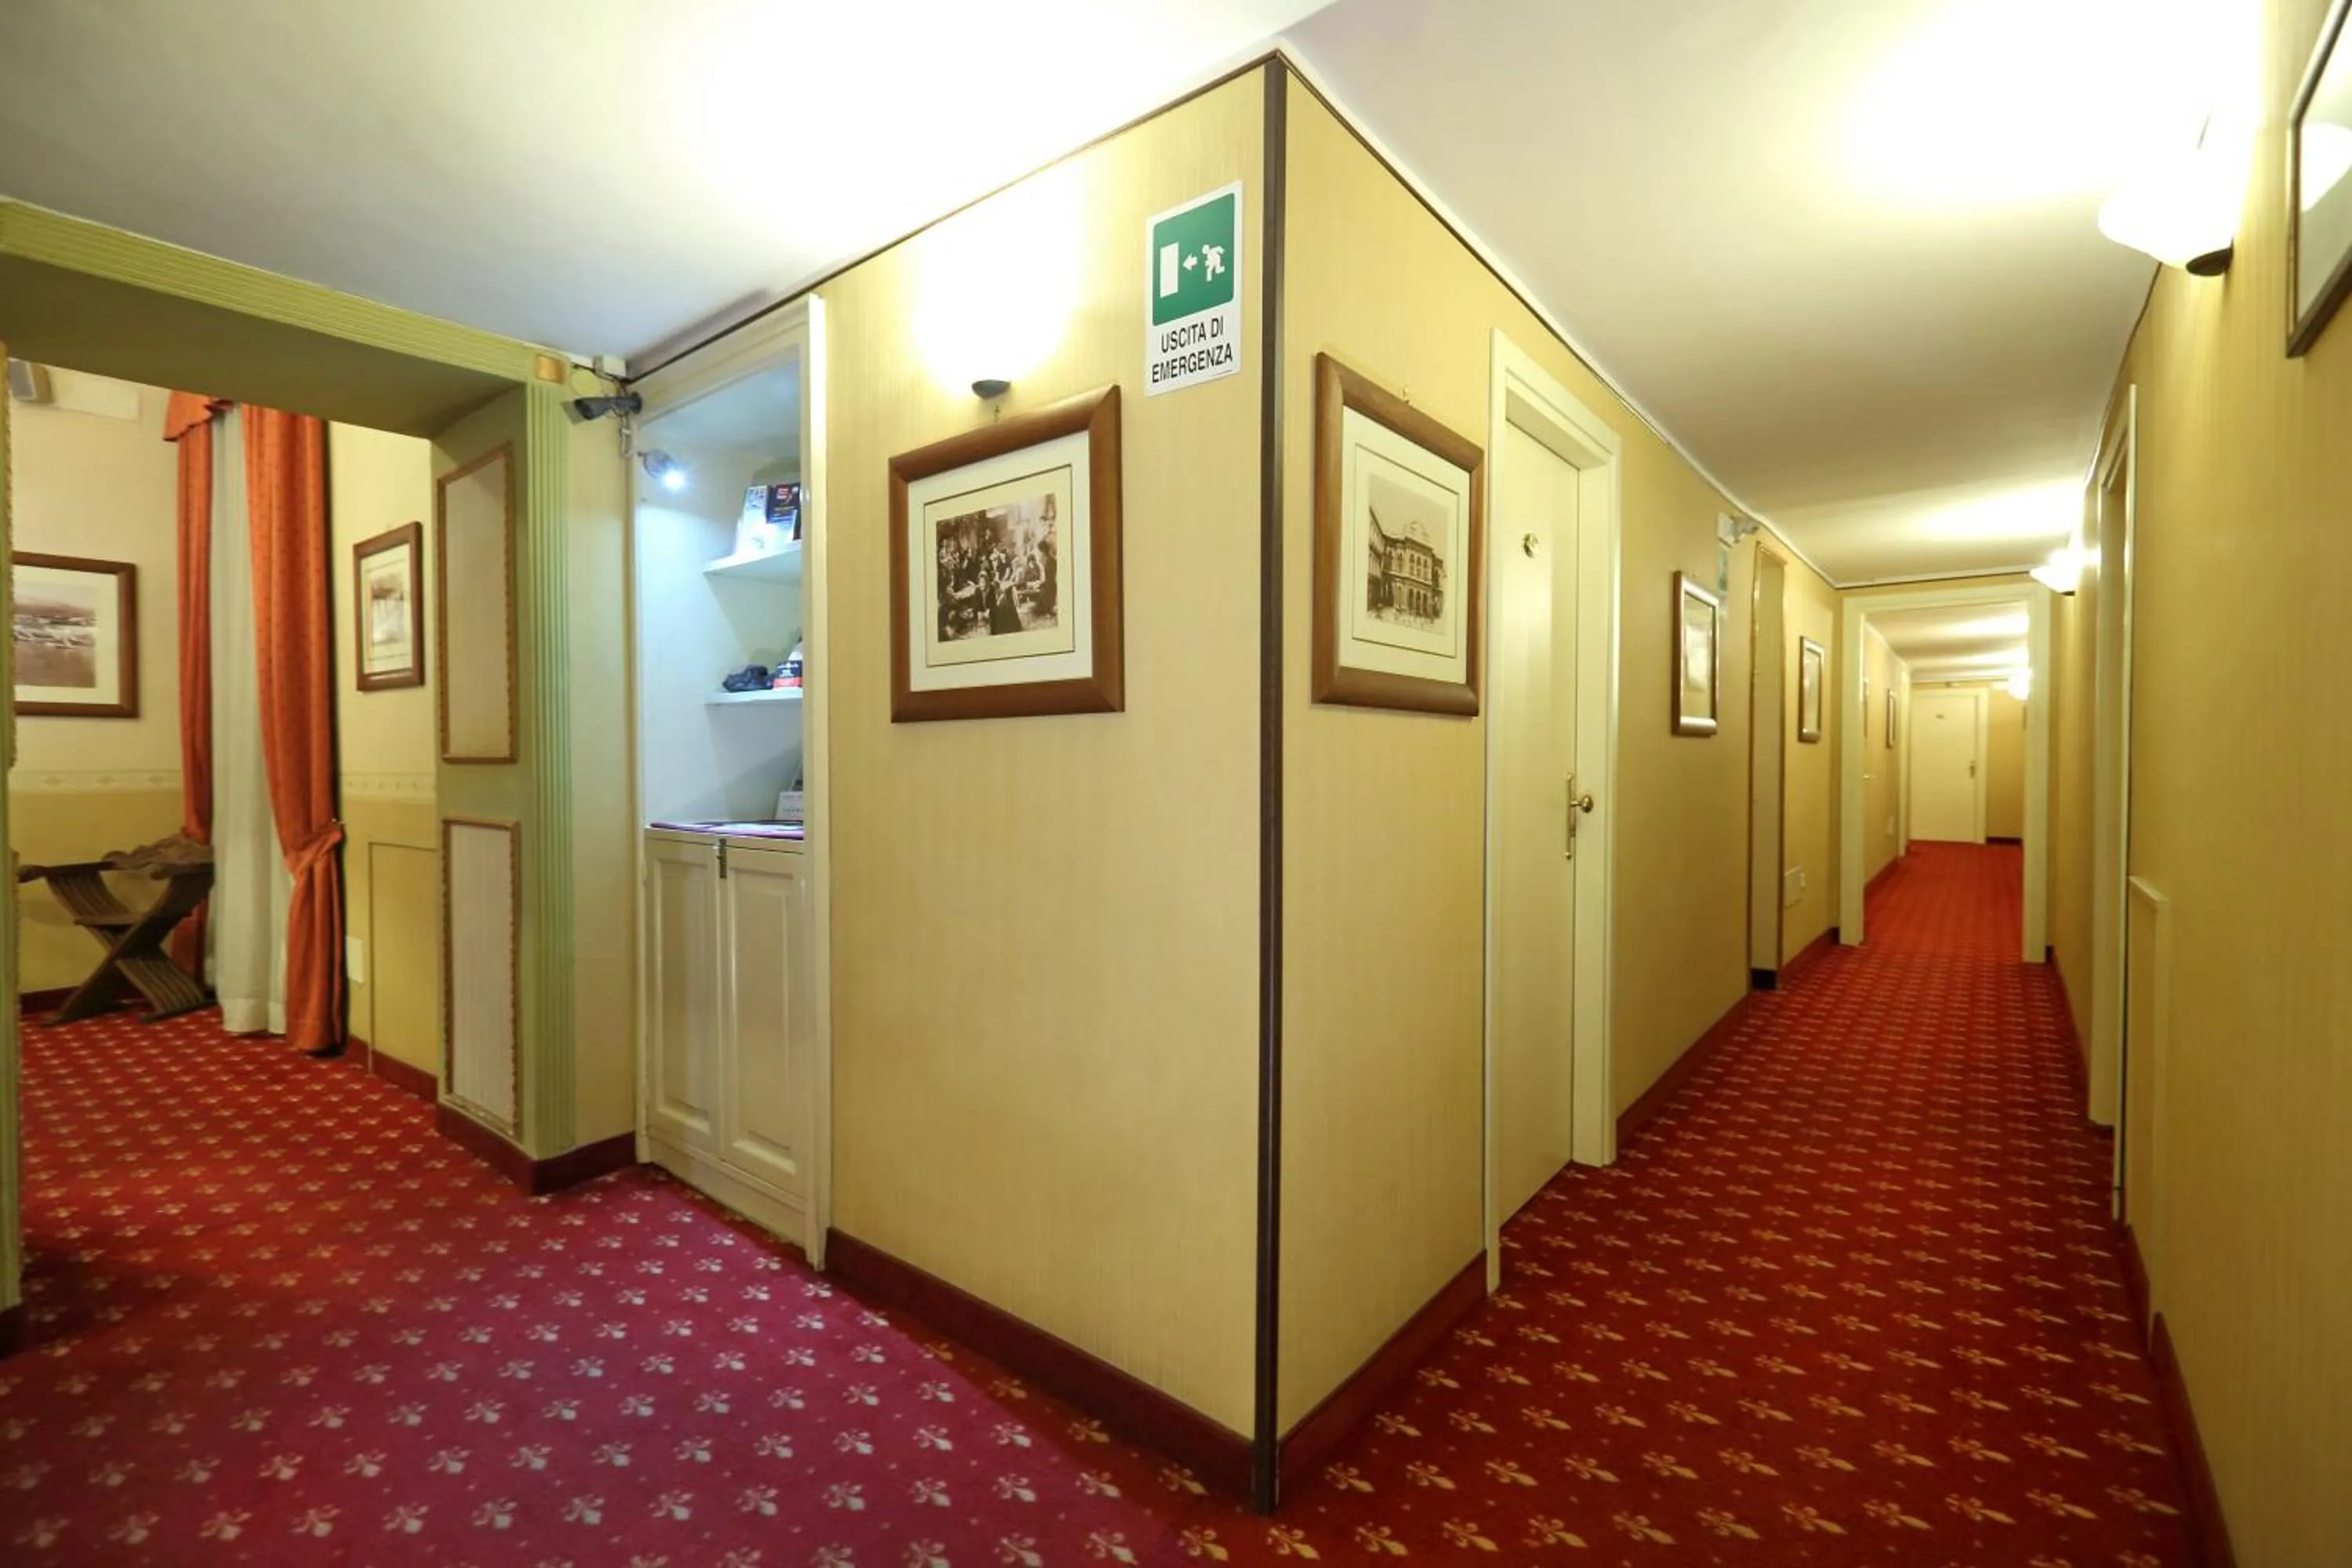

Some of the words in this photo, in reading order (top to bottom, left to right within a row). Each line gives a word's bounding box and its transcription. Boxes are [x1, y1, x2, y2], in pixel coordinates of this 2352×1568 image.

[1161, 321, 1207, 354] USCITA
[1210, 315, 1224, 338] DI
[1152, 342, 1233, 383] EMERGENZA
